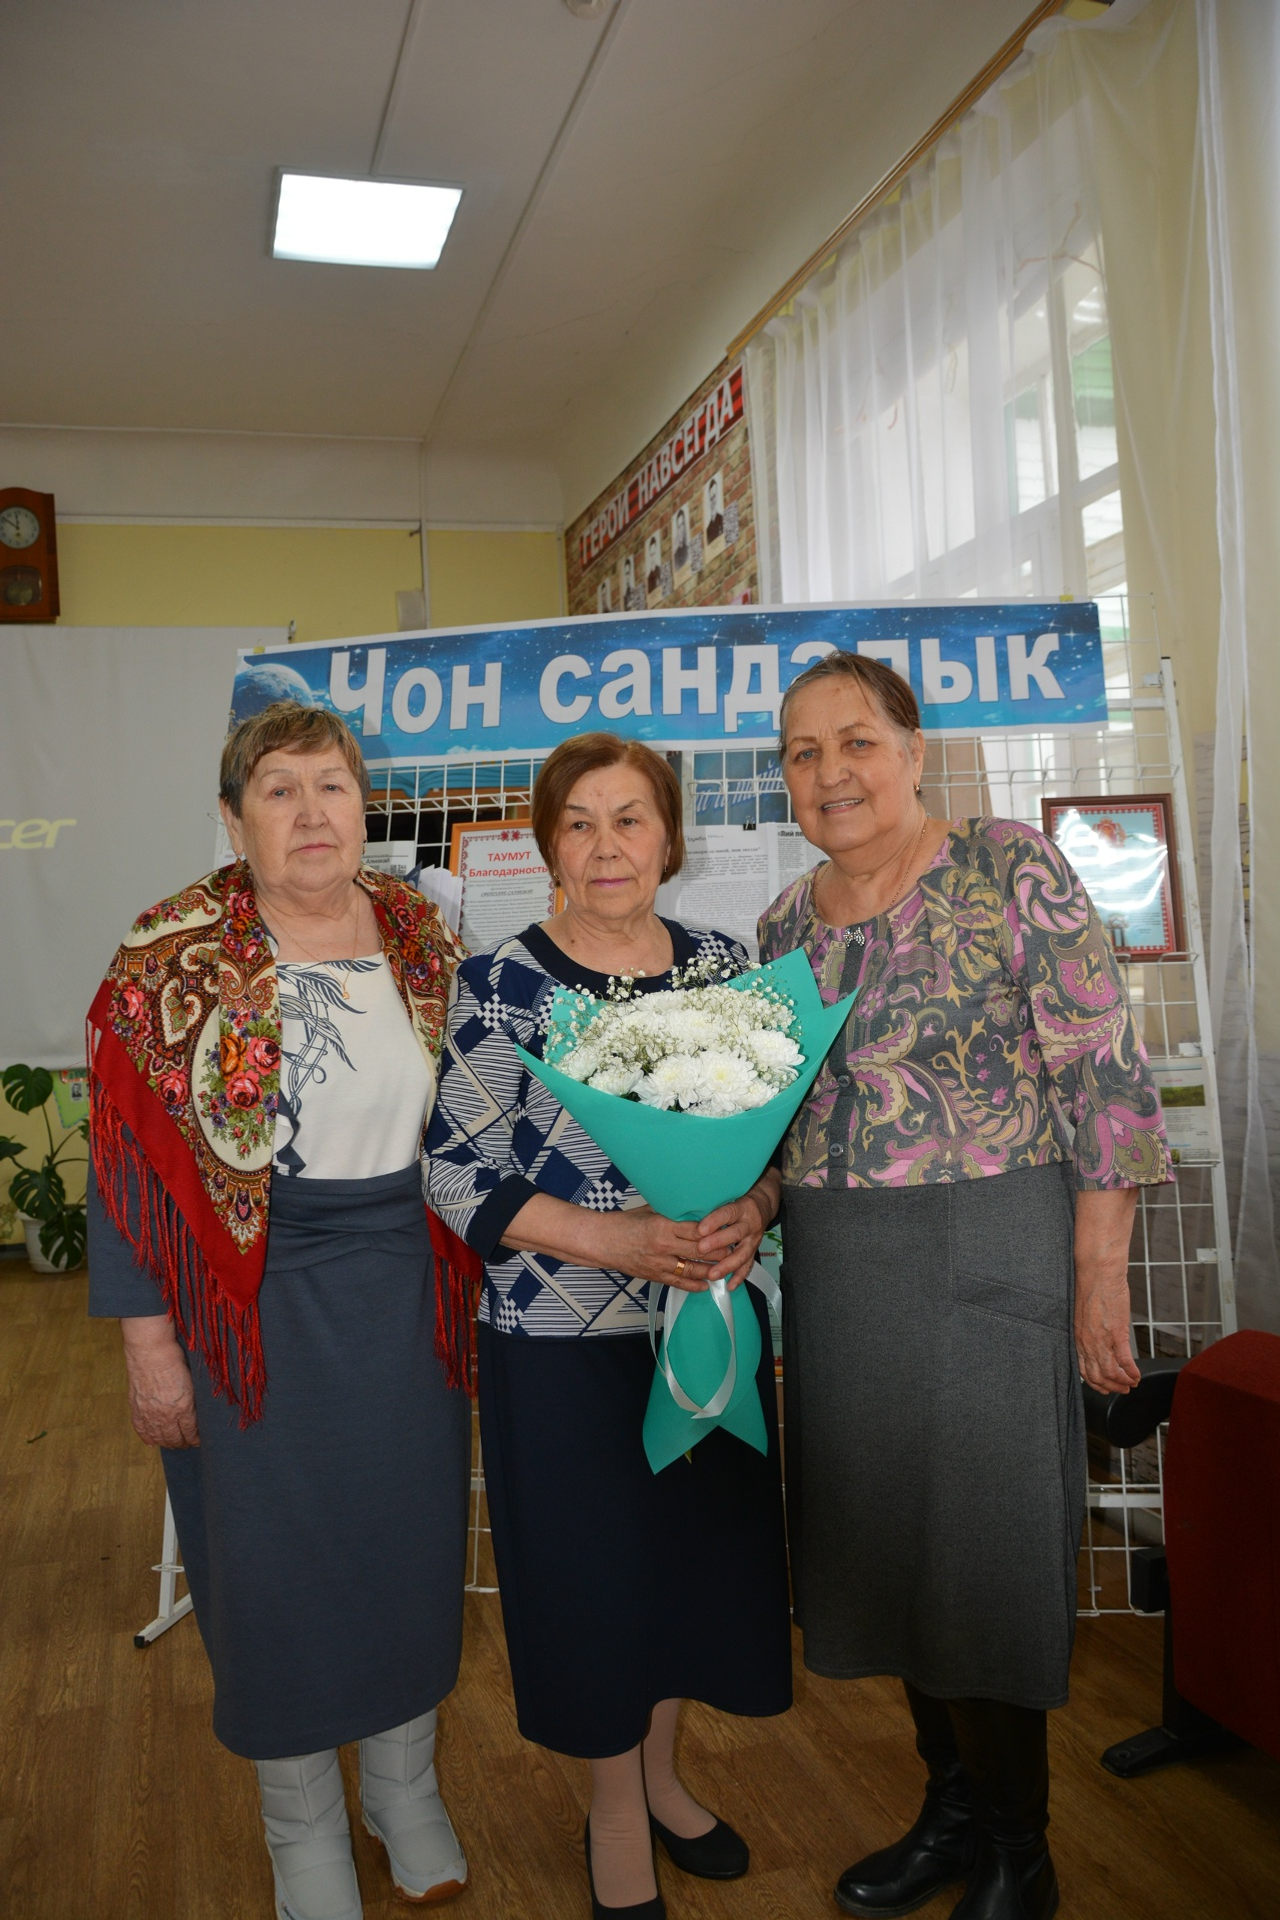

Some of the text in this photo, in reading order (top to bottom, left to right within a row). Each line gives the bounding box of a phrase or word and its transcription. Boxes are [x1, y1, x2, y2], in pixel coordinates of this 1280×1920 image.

[582, 379, 734, 565] ГЕРОИ НАВСЕГДА
[329, 647, 502, 737] Чон
[468, 866, 548, 878] Благодарность
[487, 851, 531, 862] ТАУМУТ
